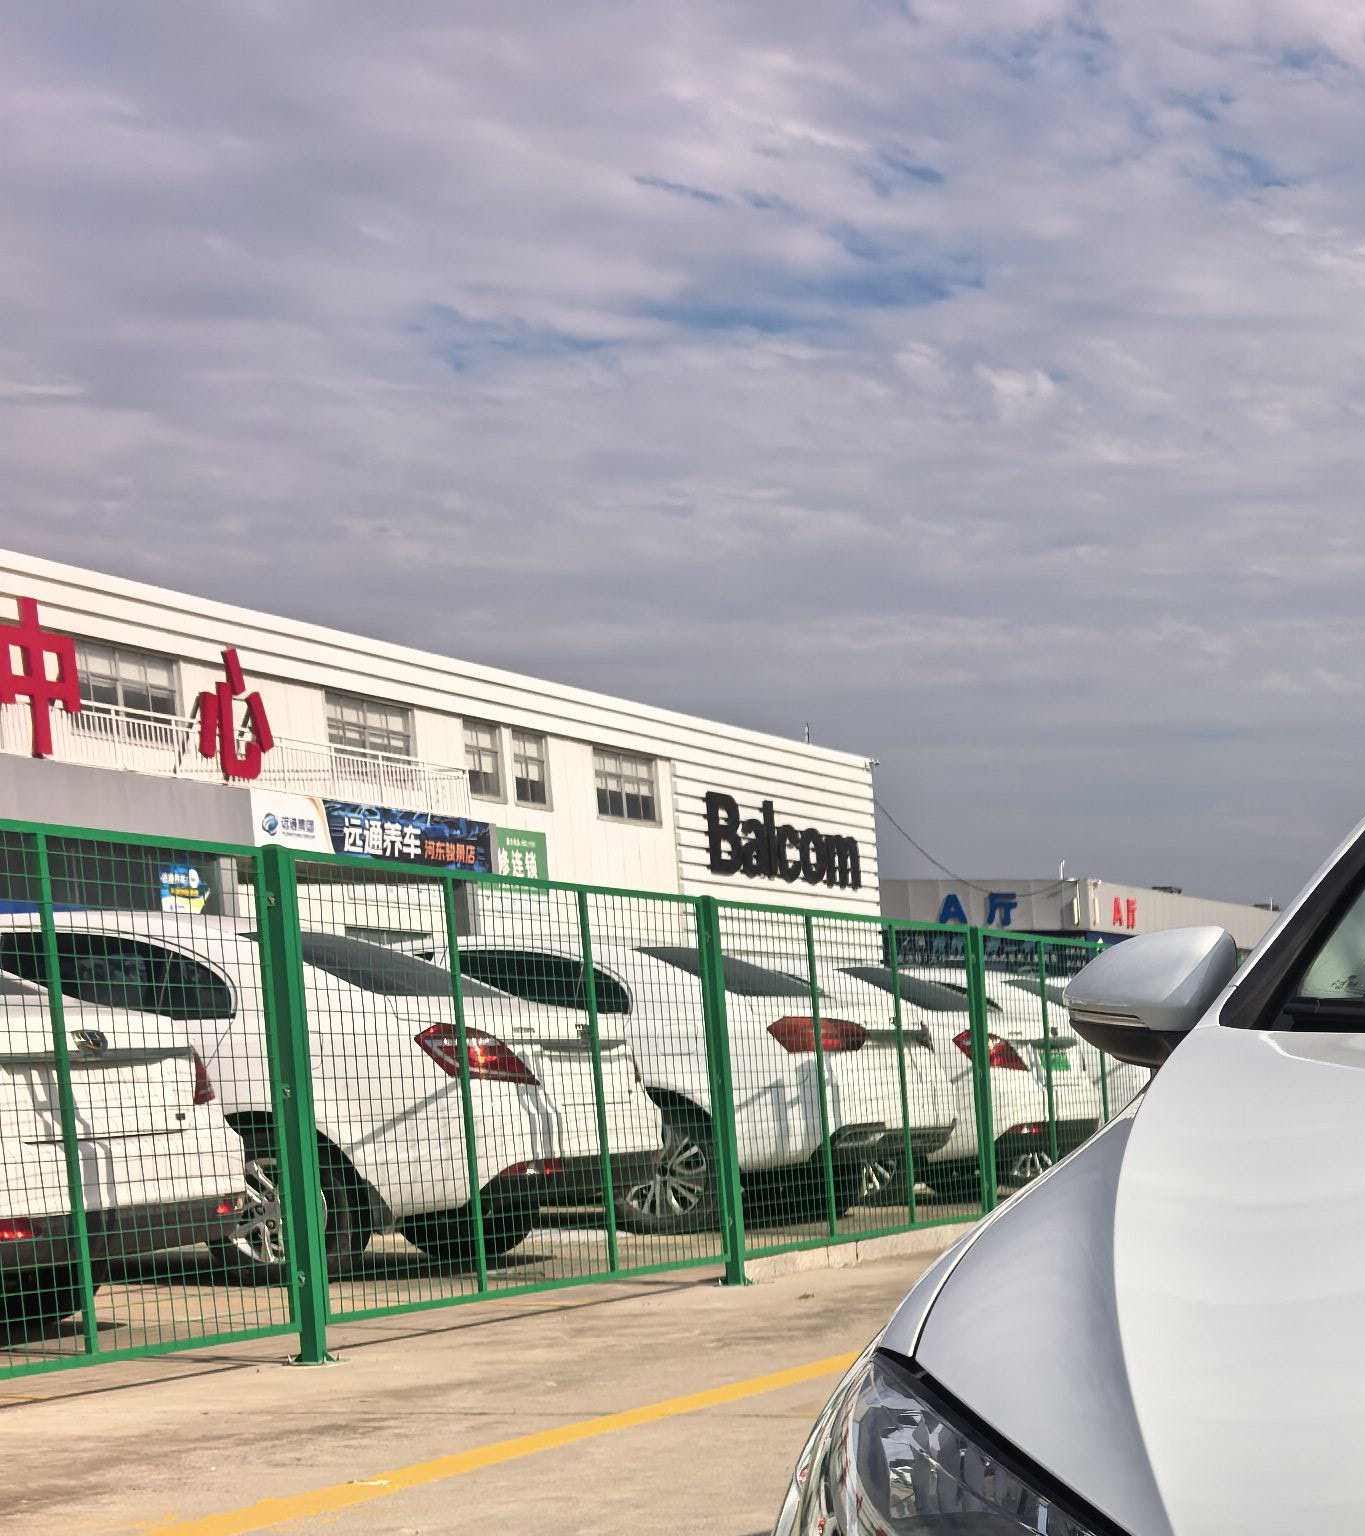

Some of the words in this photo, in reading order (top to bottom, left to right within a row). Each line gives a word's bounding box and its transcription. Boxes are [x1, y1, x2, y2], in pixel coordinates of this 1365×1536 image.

[344, 817, 422, 859] 远通养车
[705, 791, 862, 890] Balcom
